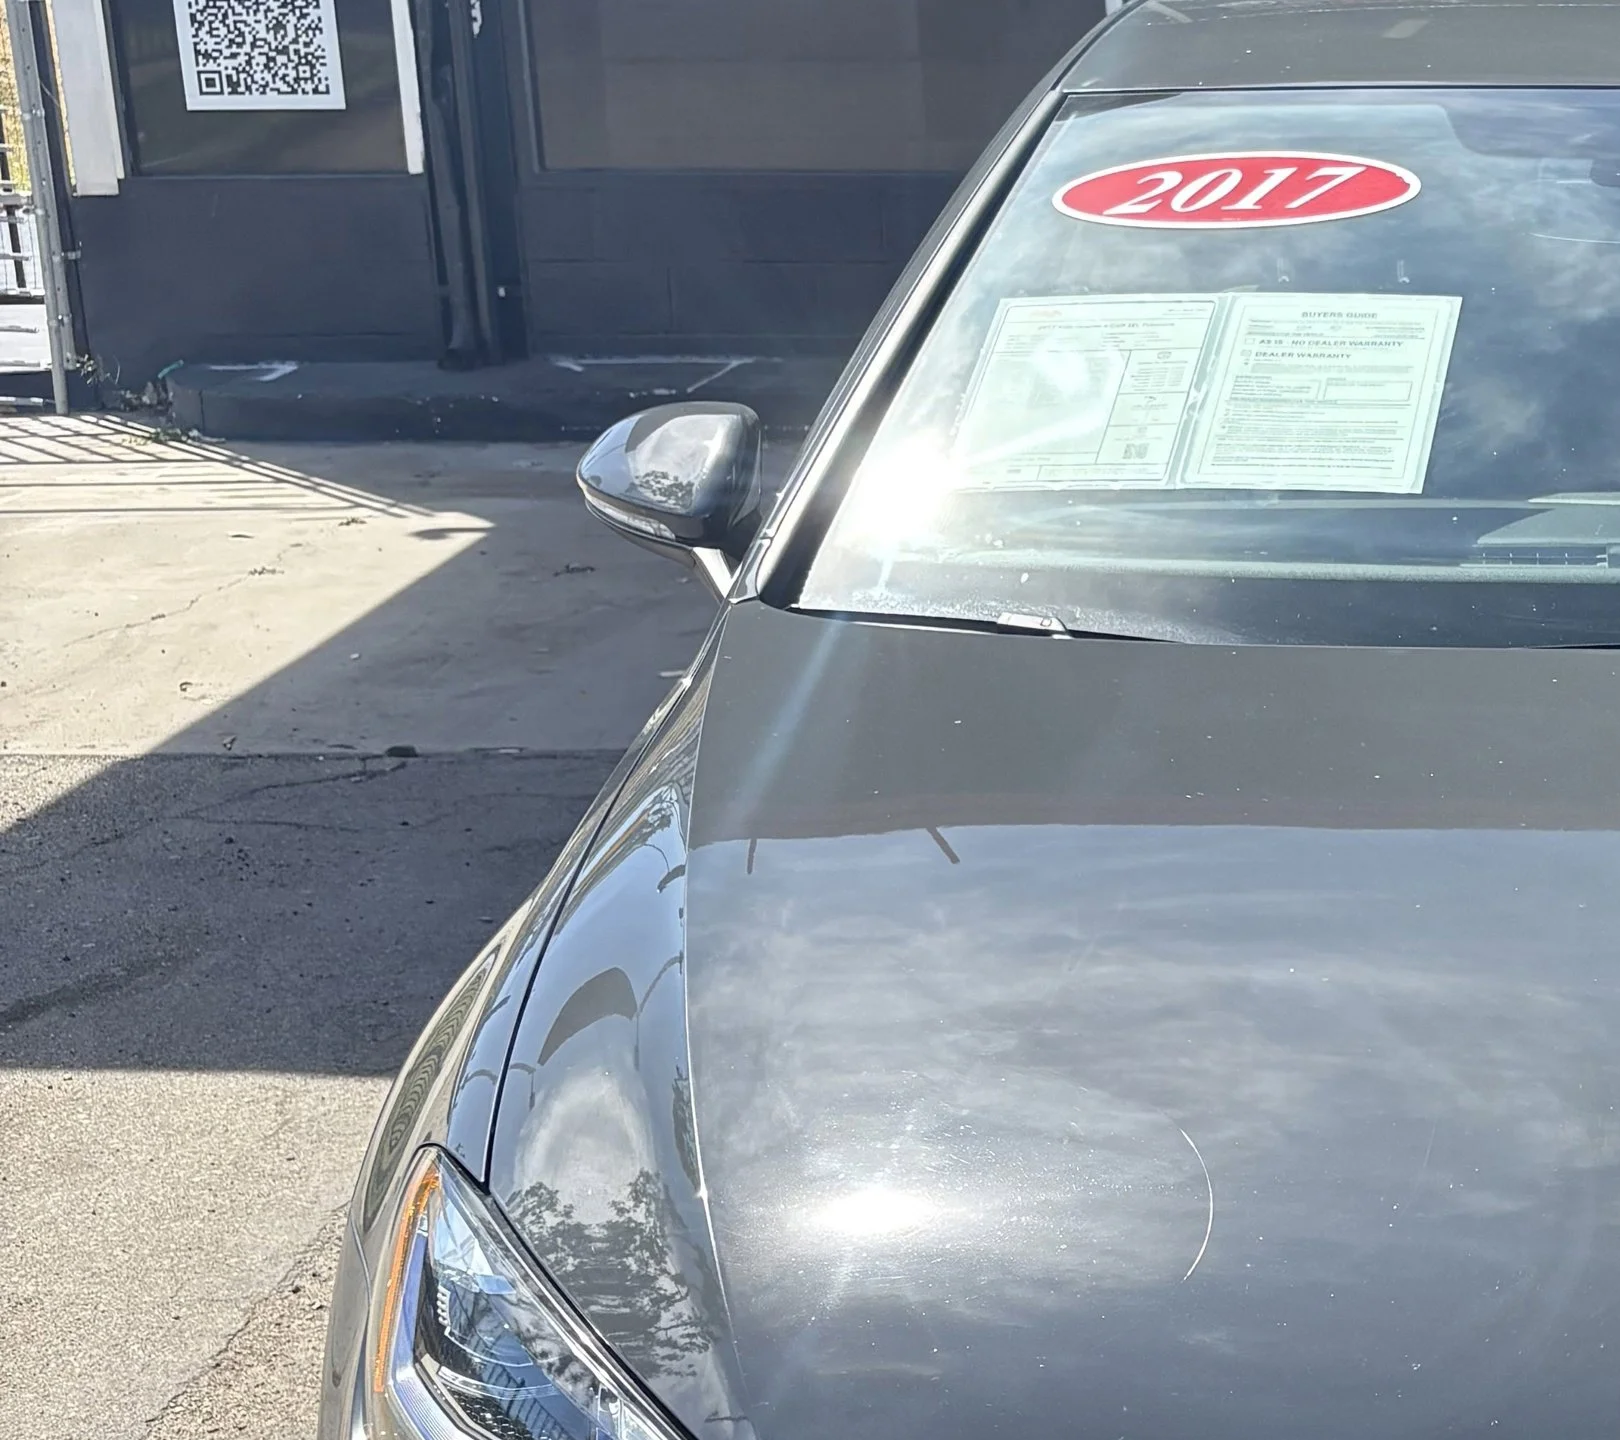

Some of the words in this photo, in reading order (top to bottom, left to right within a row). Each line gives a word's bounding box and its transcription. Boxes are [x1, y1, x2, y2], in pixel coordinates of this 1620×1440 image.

[1103, 165, 1368, 217] 2017
[1301, 311, 1344, 319] BUYERS
[1346, 311, 1379, 320] GUIDE
[1307, 340, 1347, 348] DEALER
[1348, 340, 1405, 348] WARRANTY
[1255, 351, 1295, 359] DEALER
[1296, 352, 1353, 360] WARRANTY
